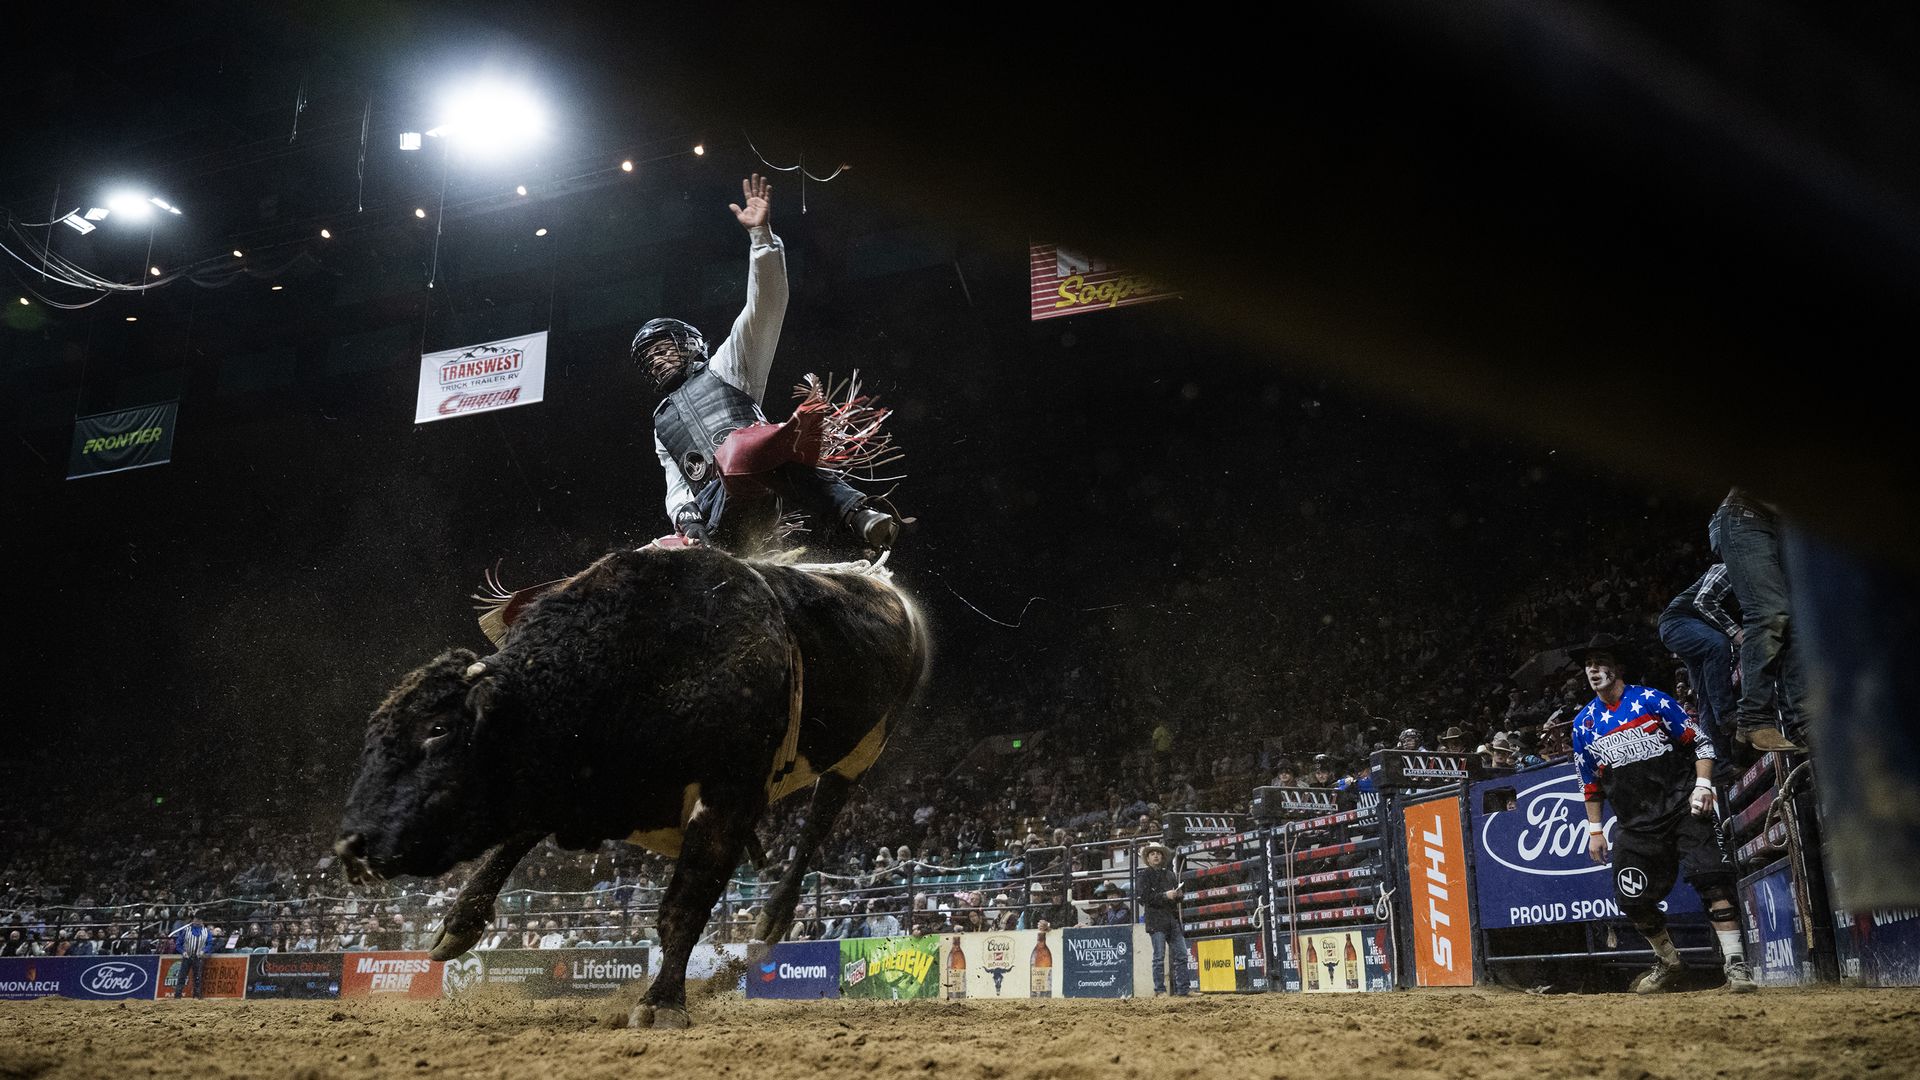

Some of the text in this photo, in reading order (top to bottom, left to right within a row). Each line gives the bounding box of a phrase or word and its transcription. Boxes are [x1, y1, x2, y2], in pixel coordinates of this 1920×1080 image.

[442, 353, 521, 382] TRANSWEST
[441, 372, 520, 392] TRUCK TRAILER RV
[82, 426, 163, 455] FRONTIER
[1586, 727, 1649, 757] NATIONAL
[1598, 738, 1662, 765] WESTERN
[1423, 814, 1452, 971] STIHL
[1510, 902, 1567, 925] PROUD
[986, 939, 1010, 952] Coors
[1068, 938, 1113, 952] NATIONAL
[1075, 949, 1119, 961] WESTERN
[1234, 955, 1246, 970] CAT
[356, 957, 431, 974] MATTRESS
[524, 967, 545, 975] STATE
[573, 958, 643, 979] Lifetime
[779, 963, 827, 979] Chevron
[868, 961, 881, 977] DO
[895, 948, 934, 984] DEW
[1211, 959, 1232, 968] WAGNER
[92, 965, 135, 990] Ford
[219, 966, 240, 980] BUCK
[0, 981, 60, 991] MONARCH
[164, 976, 189, 987] LOTTY
[217, 981, 237, 994] BACK
[370, 973, 414, 990] FIRM
[1078, 979, 1112, 988] CommonSpirit
